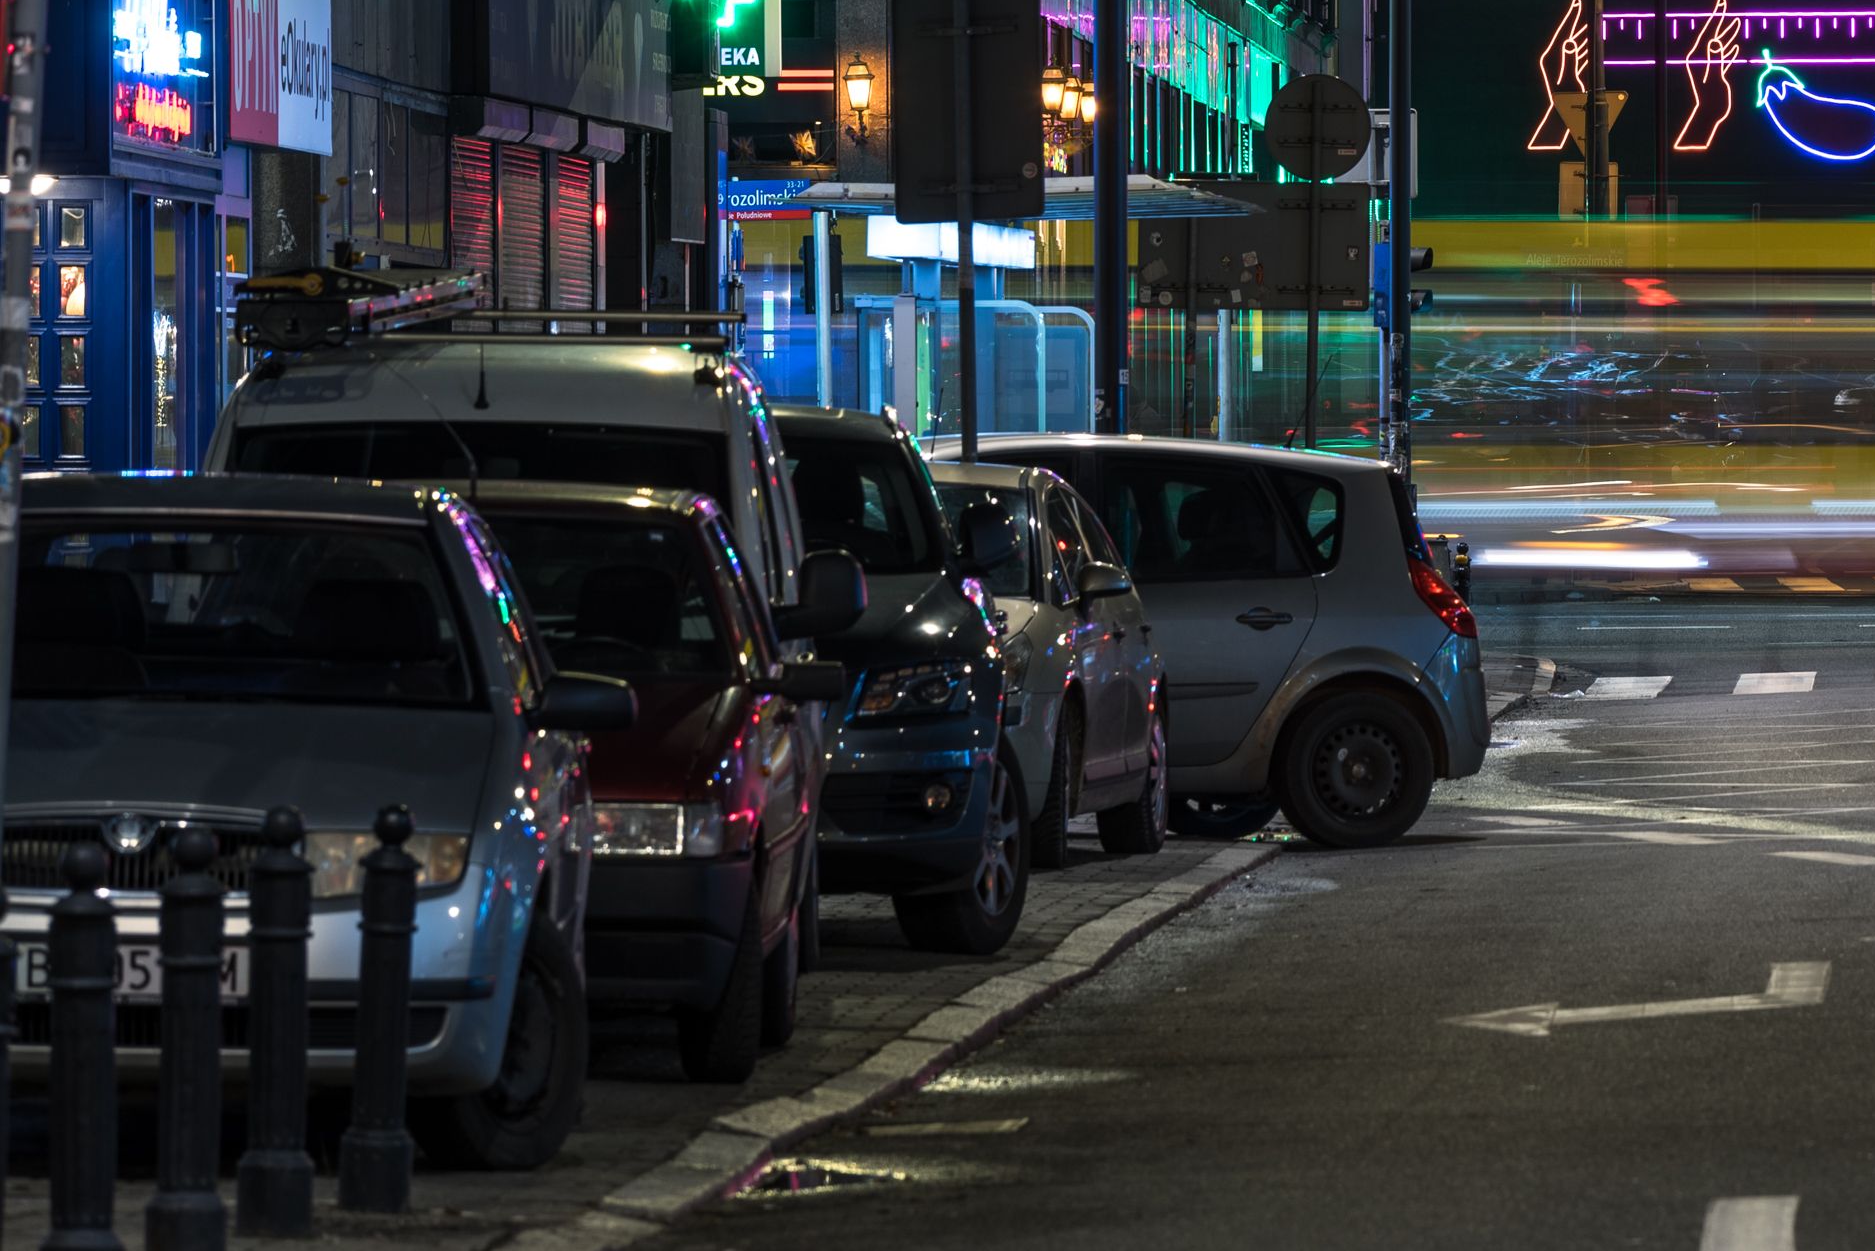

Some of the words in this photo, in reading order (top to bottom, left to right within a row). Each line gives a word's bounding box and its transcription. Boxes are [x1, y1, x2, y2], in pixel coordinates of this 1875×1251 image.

[720, 47, 761, 66] EKA
[280, 18, 330, 122] eOkulary.pl
[786, 180, 805, 189] 33-21
